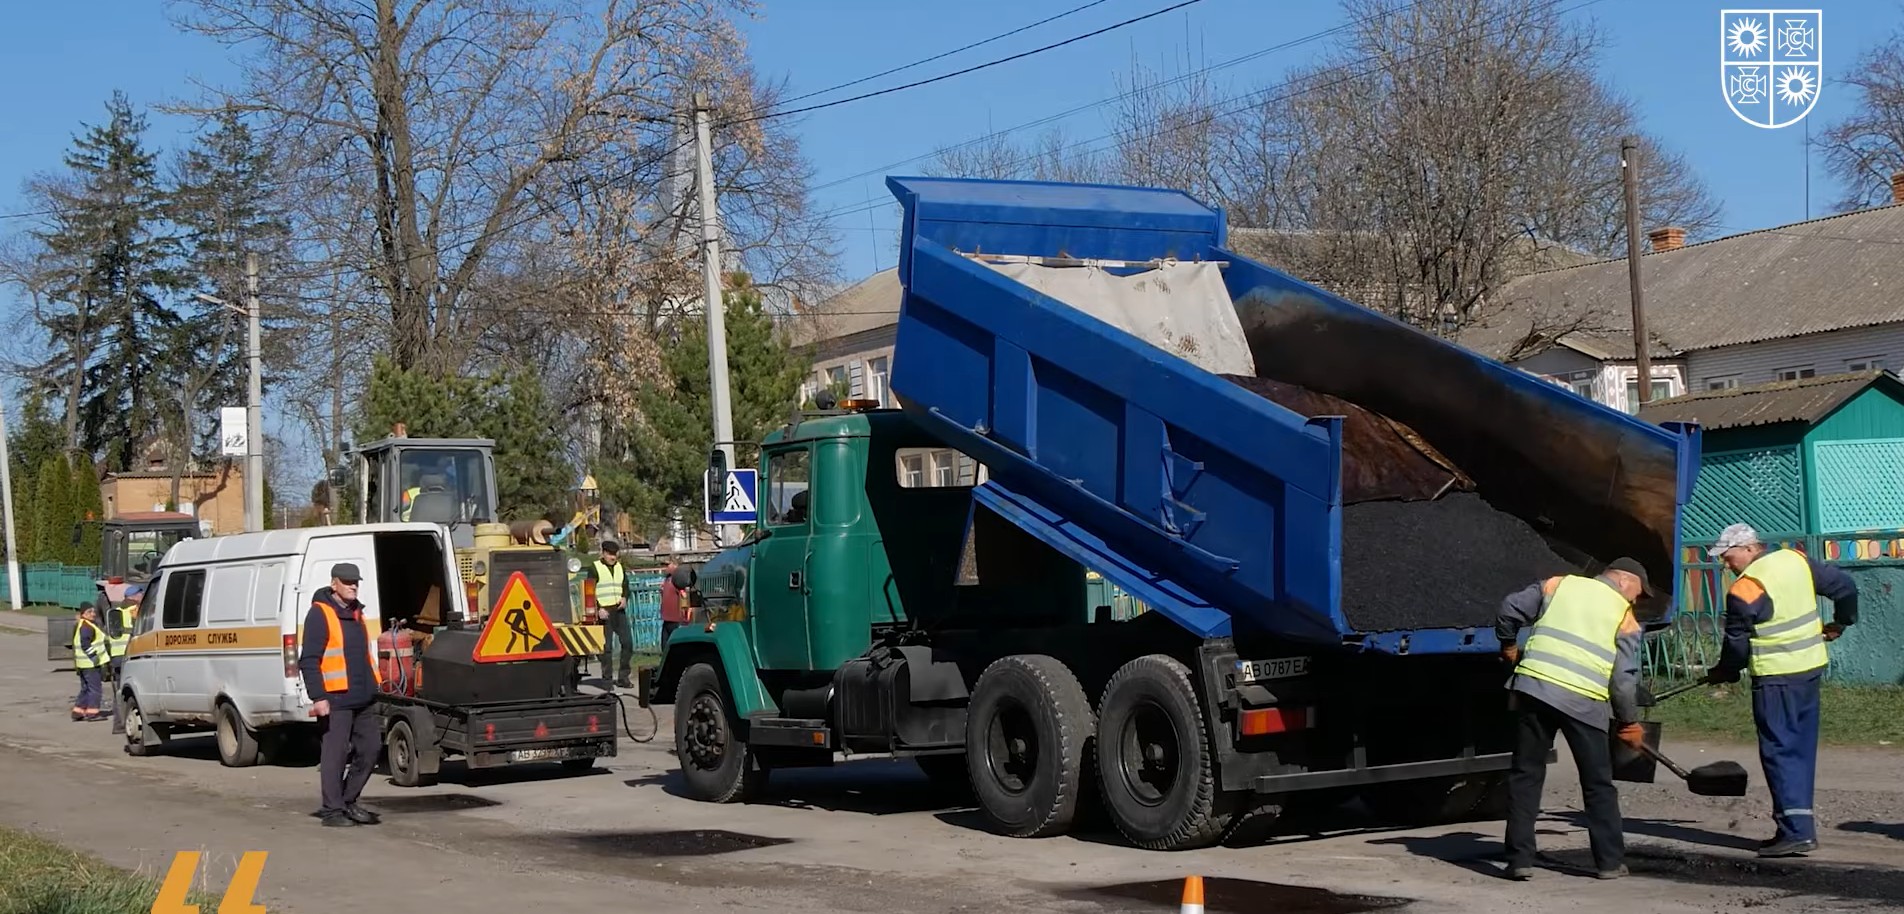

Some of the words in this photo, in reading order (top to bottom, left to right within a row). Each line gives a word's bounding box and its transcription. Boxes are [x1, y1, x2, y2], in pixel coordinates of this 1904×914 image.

[165, 633, 197, 646] ДОРОЖНЯ
[207, 632, 238, 644] СЛУЖБА
[1244, 664, 1260, 678] AB
[1264, 660, 1291, 676] 0787
